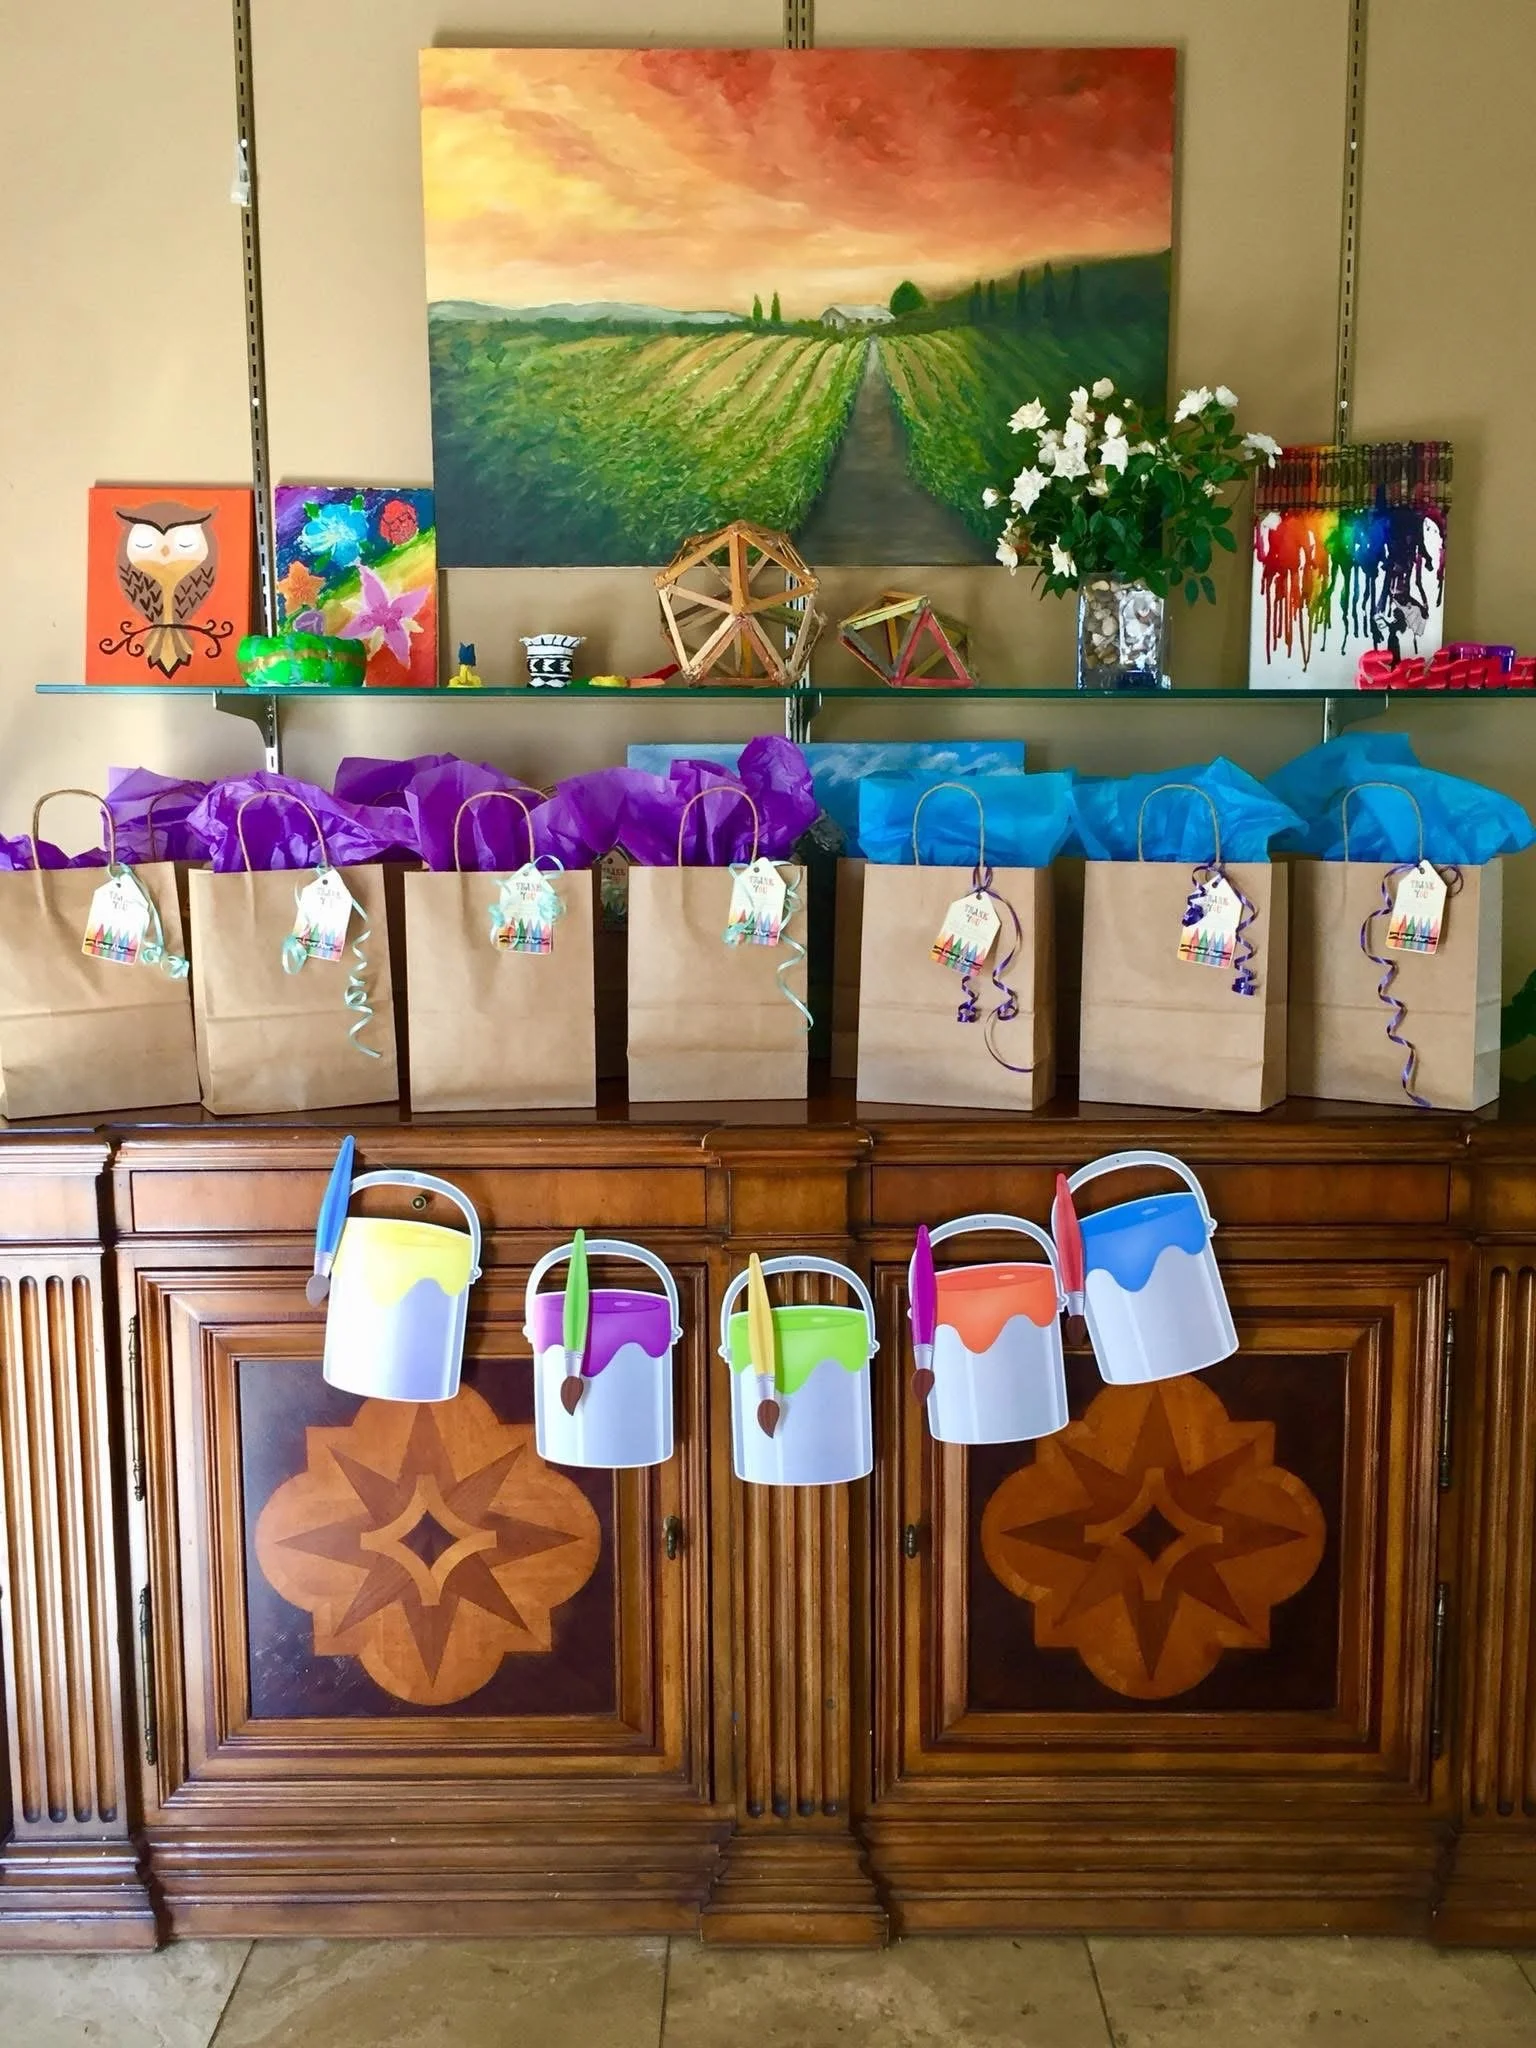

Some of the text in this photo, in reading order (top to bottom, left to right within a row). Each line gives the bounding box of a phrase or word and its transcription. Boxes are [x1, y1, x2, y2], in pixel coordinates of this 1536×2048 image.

[1411, 880, 1437, 891] THANK
[1413, 889, 1429, 900] YOU
[964, 903, 990, 921] THANK
[966, 914, 982, 927] YOU
